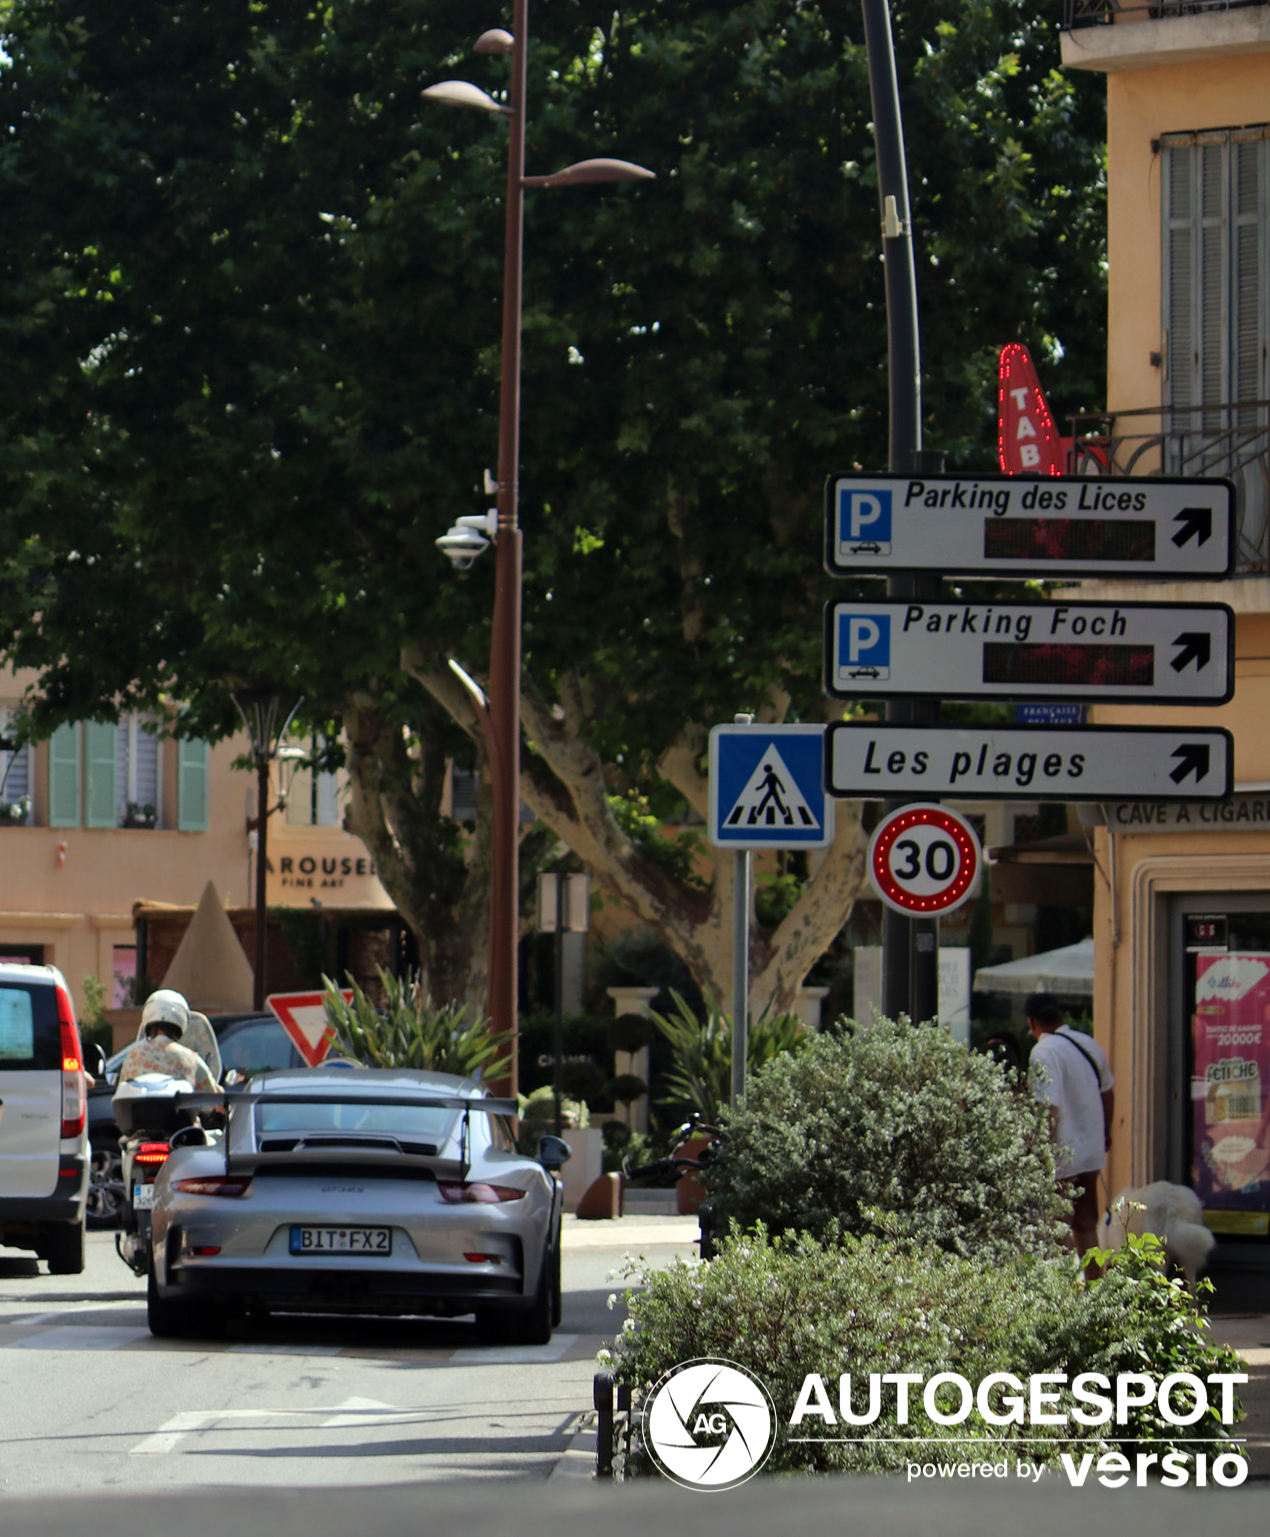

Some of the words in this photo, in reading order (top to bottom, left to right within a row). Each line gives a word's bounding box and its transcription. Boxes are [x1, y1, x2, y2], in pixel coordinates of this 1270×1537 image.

[1011, 387, 1040, 468] TAB
[904, 481, 1011, 516] Parking
[1022, 485, 1067, 511] des
[1078, 484, 1147, 512] Lices
[903, 605, 1032, 642] Parking
[1050, 608, 1128, 636] Foch
[864, 741, 929, 775] Les
[949, 743, 1086, 787] plages
[1116, 804, 1167, 824] CAVE
[895, 839, 955, 881] 30
[282, 878, 313, 888] FINE
[321, 878, 345, 888] ART
[301, 1230, 337, 1249] BIT
